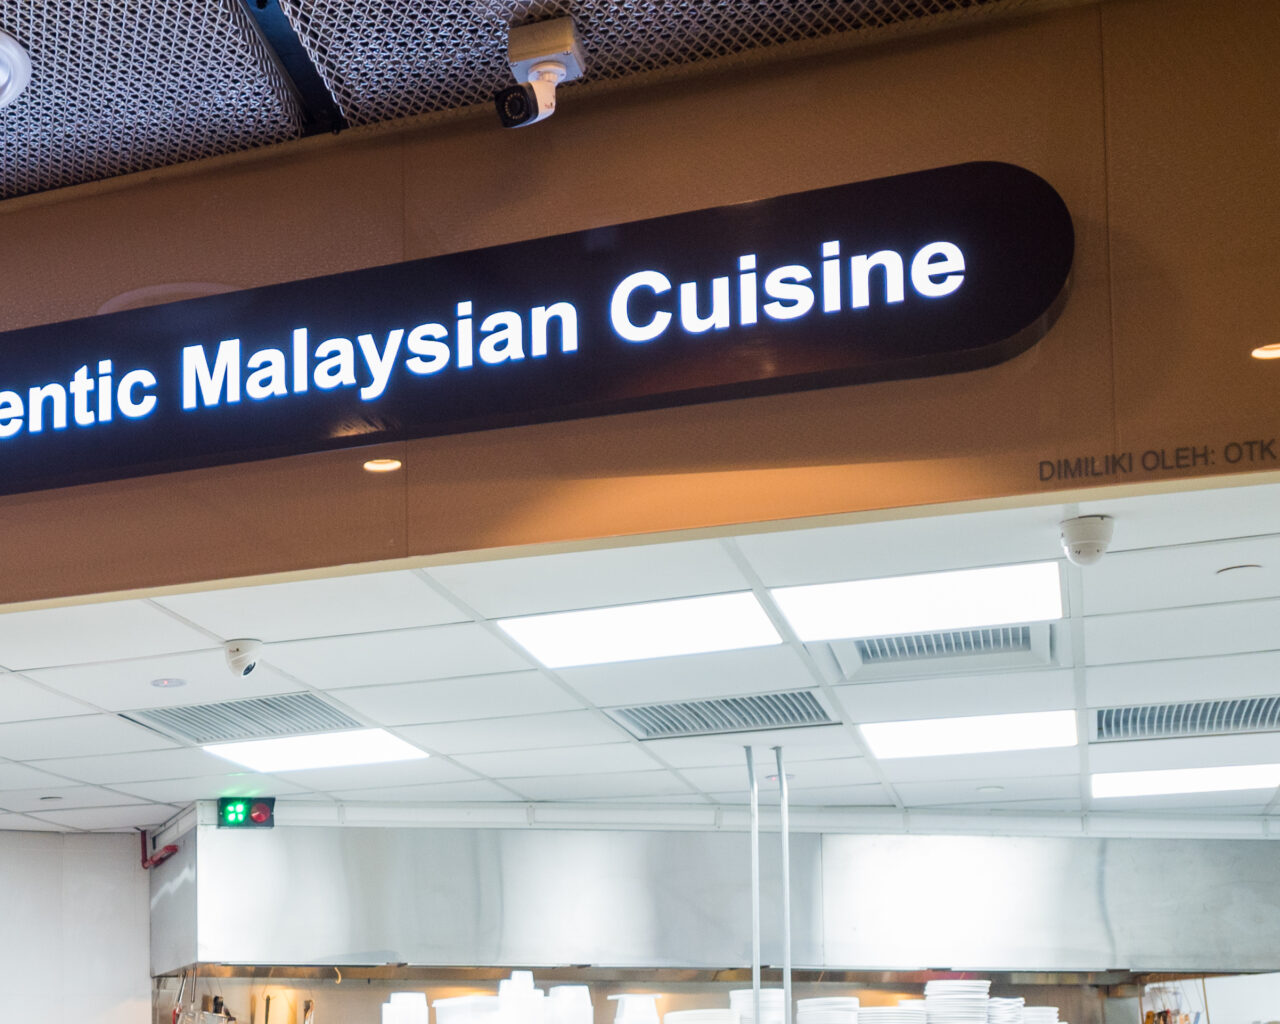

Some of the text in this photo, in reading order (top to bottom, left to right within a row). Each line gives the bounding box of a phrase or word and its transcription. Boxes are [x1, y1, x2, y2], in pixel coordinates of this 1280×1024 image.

[182, 300, 579, 411] Malaysian
[609, 239, 967, 342] Cuisine
[1038, 438, 1277, 482] DIMILIKI OLEH: OTK
